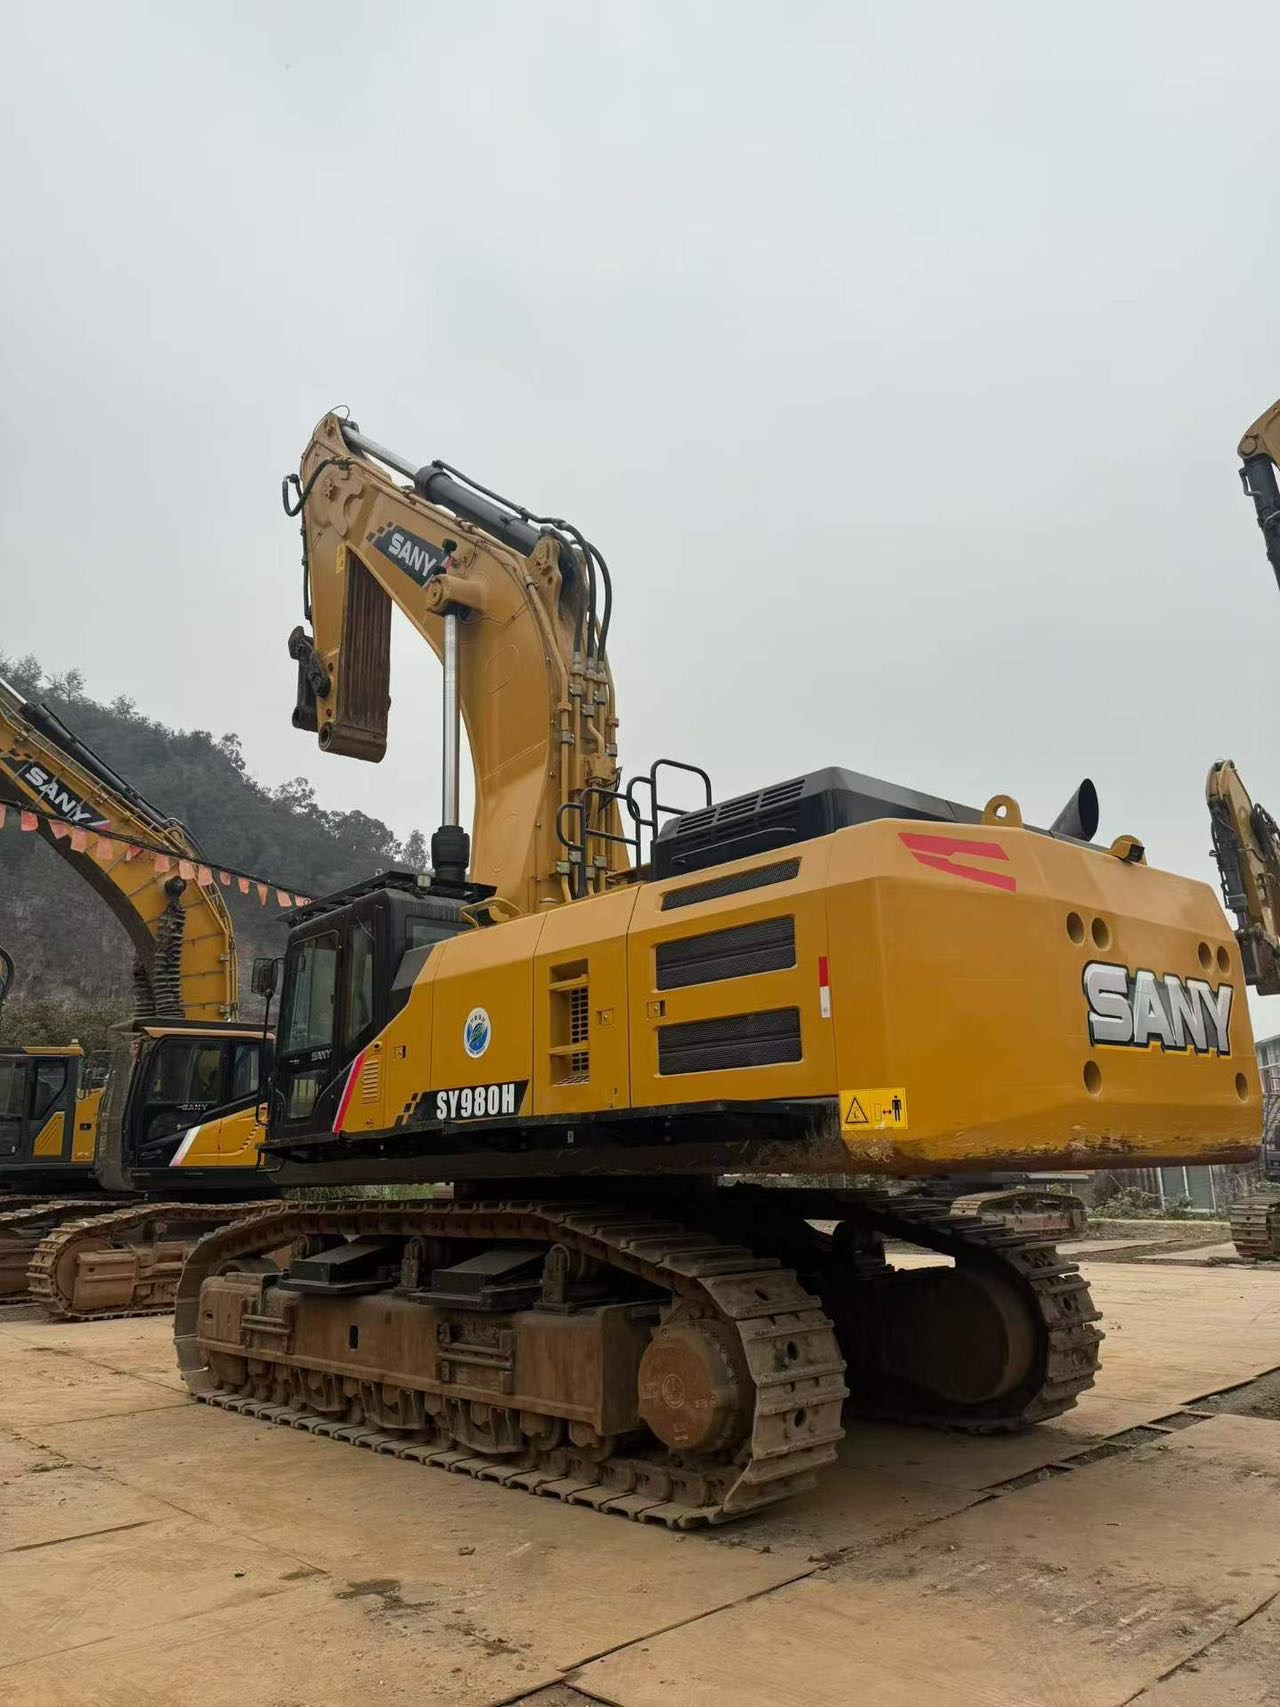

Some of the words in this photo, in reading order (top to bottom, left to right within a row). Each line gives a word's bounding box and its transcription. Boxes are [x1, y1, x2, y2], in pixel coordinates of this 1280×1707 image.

[388, 533, 437, 577] SANY
[25, 767, 92, 822] SANY
[1083, 961, 1233, 1056] SANY
[436, 1083, 515, 1120] SY980H
